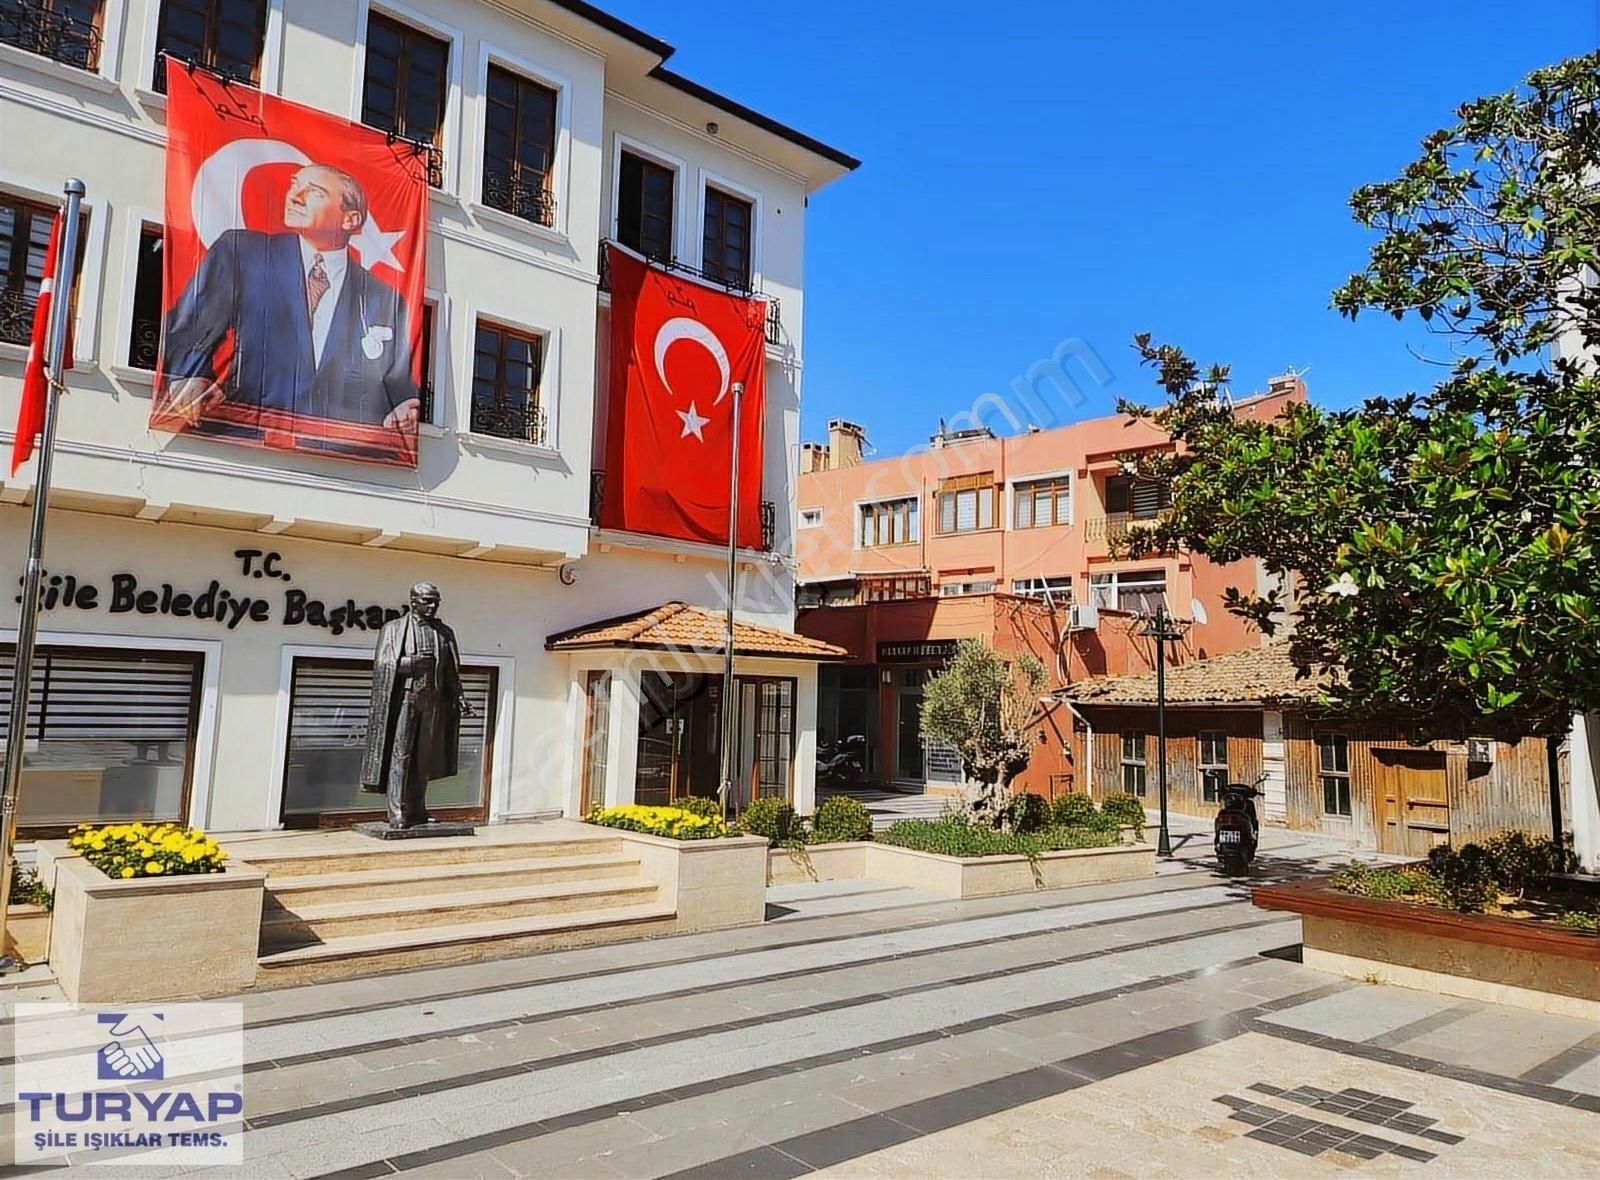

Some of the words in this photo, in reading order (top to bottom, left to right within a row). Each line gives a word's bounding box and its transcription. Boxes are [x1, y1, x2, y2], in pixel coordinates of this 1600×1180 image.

[234, 549, 291, 582] T.C.
[109, 573, 270, 629] Belediye
[283, 589, 411, 635] Başkan
